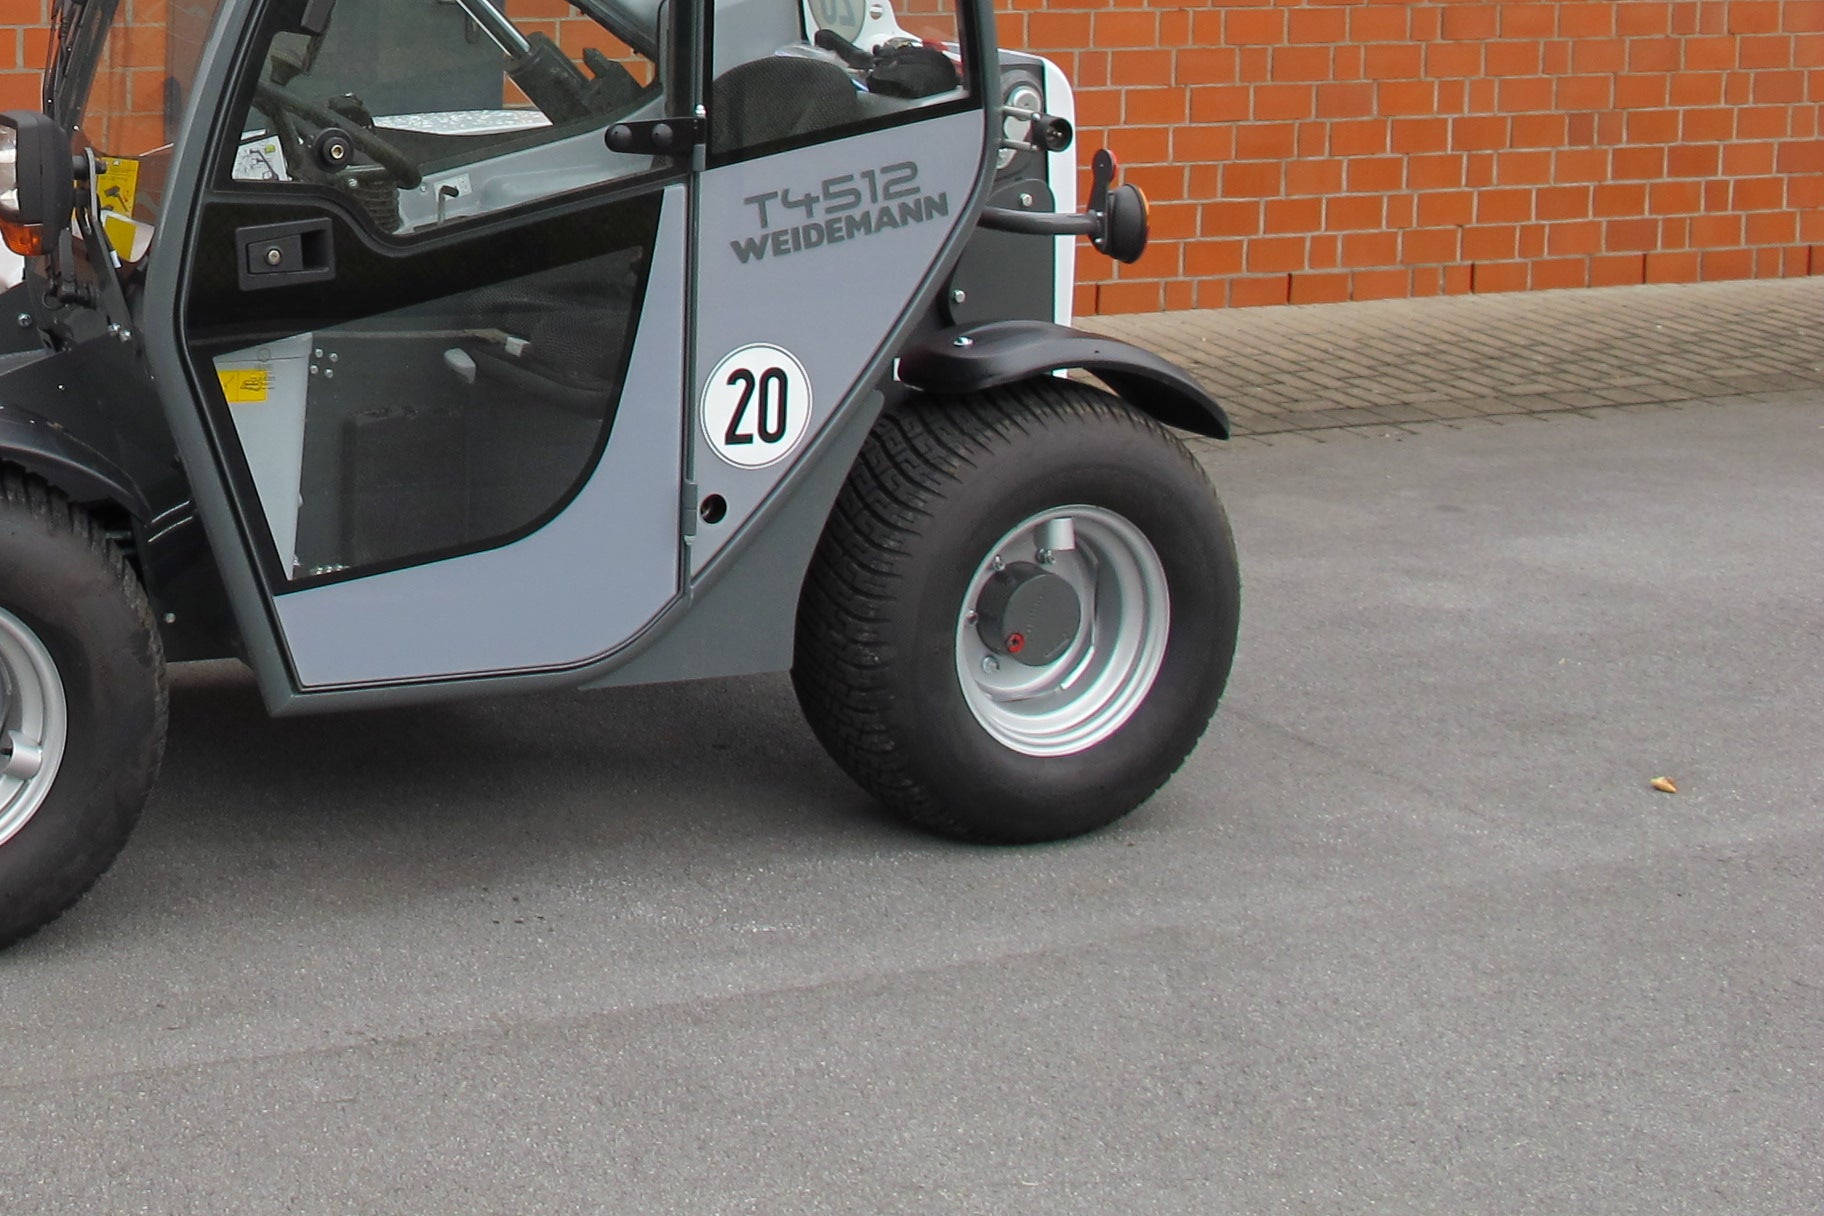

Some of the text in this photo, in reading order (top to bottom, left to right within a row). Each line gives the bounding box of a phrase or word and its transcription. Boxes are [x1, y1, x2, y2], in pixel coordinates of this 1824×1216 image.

[730, 192, 949, 264] WEIDEMANN
[744, 161, 921, 229] T4512
[725, 367, 788, 445] 20
